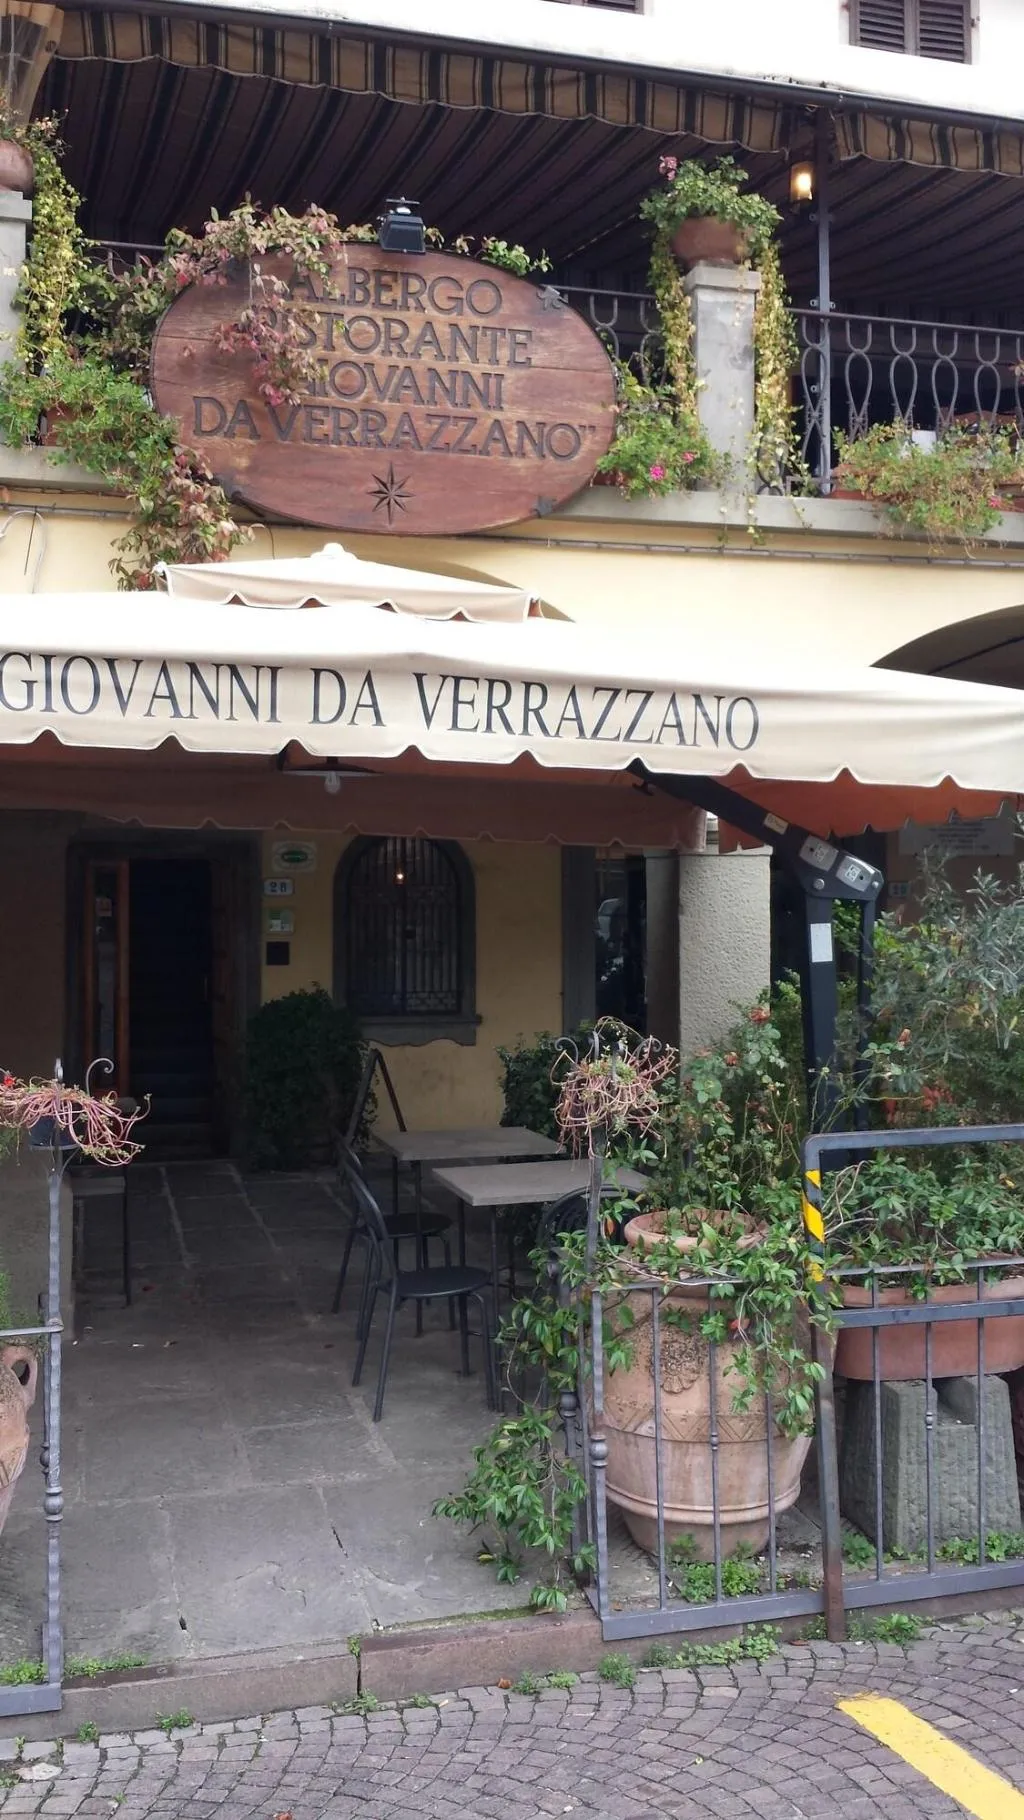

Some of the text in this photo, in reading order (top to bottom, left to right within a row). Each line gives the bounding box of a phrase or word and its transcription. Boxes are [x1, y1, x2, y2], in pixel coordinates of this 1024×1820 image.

[284, 264, 503, 316] ALBERGO
[290, 358, 505, 411] IOVANNI
[192, 396, 260, 440] DA
[0, 651, 760, 751] GIOVANNI DA VERRAZZANO
